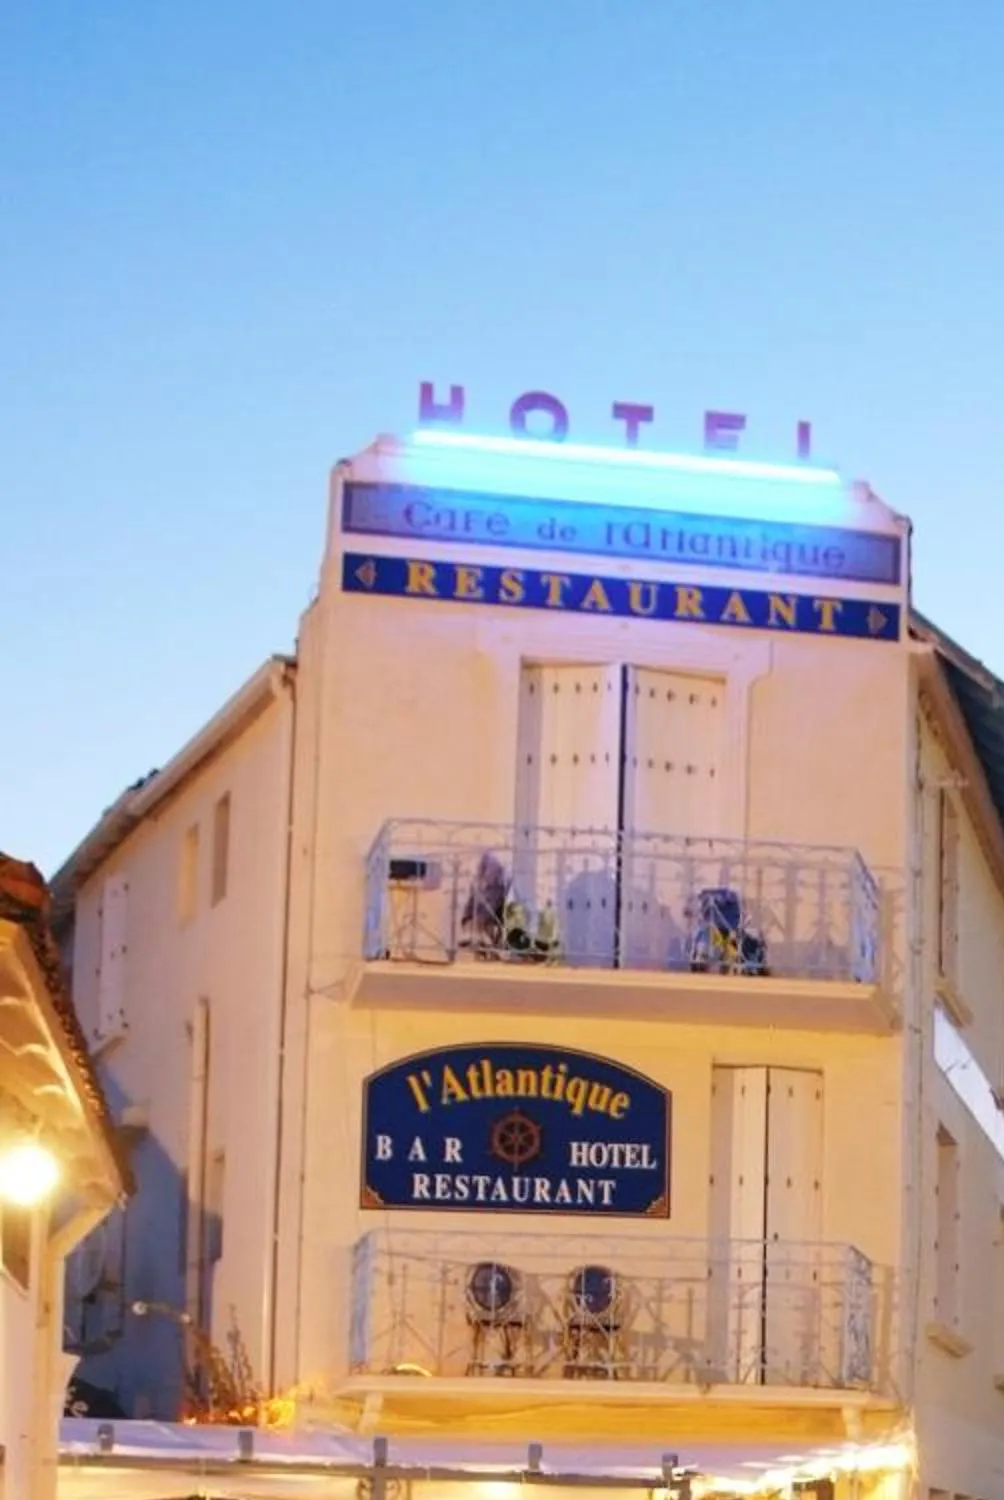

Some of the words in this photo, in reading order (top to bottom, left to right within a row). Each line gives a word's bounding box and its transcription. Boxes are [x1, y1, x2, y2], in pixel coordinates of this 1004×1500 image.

[536, 516, 578, 543] de
[404, 558, 844, 632] RESTAURANT
[407, 1057, 631, 1120] l'Atlantique
[375, 1134, 464, 1164] BAR
[569, 1140, 658, 1170] HOTEL
[412, 1173, 617, 1206] RESTAURANT
